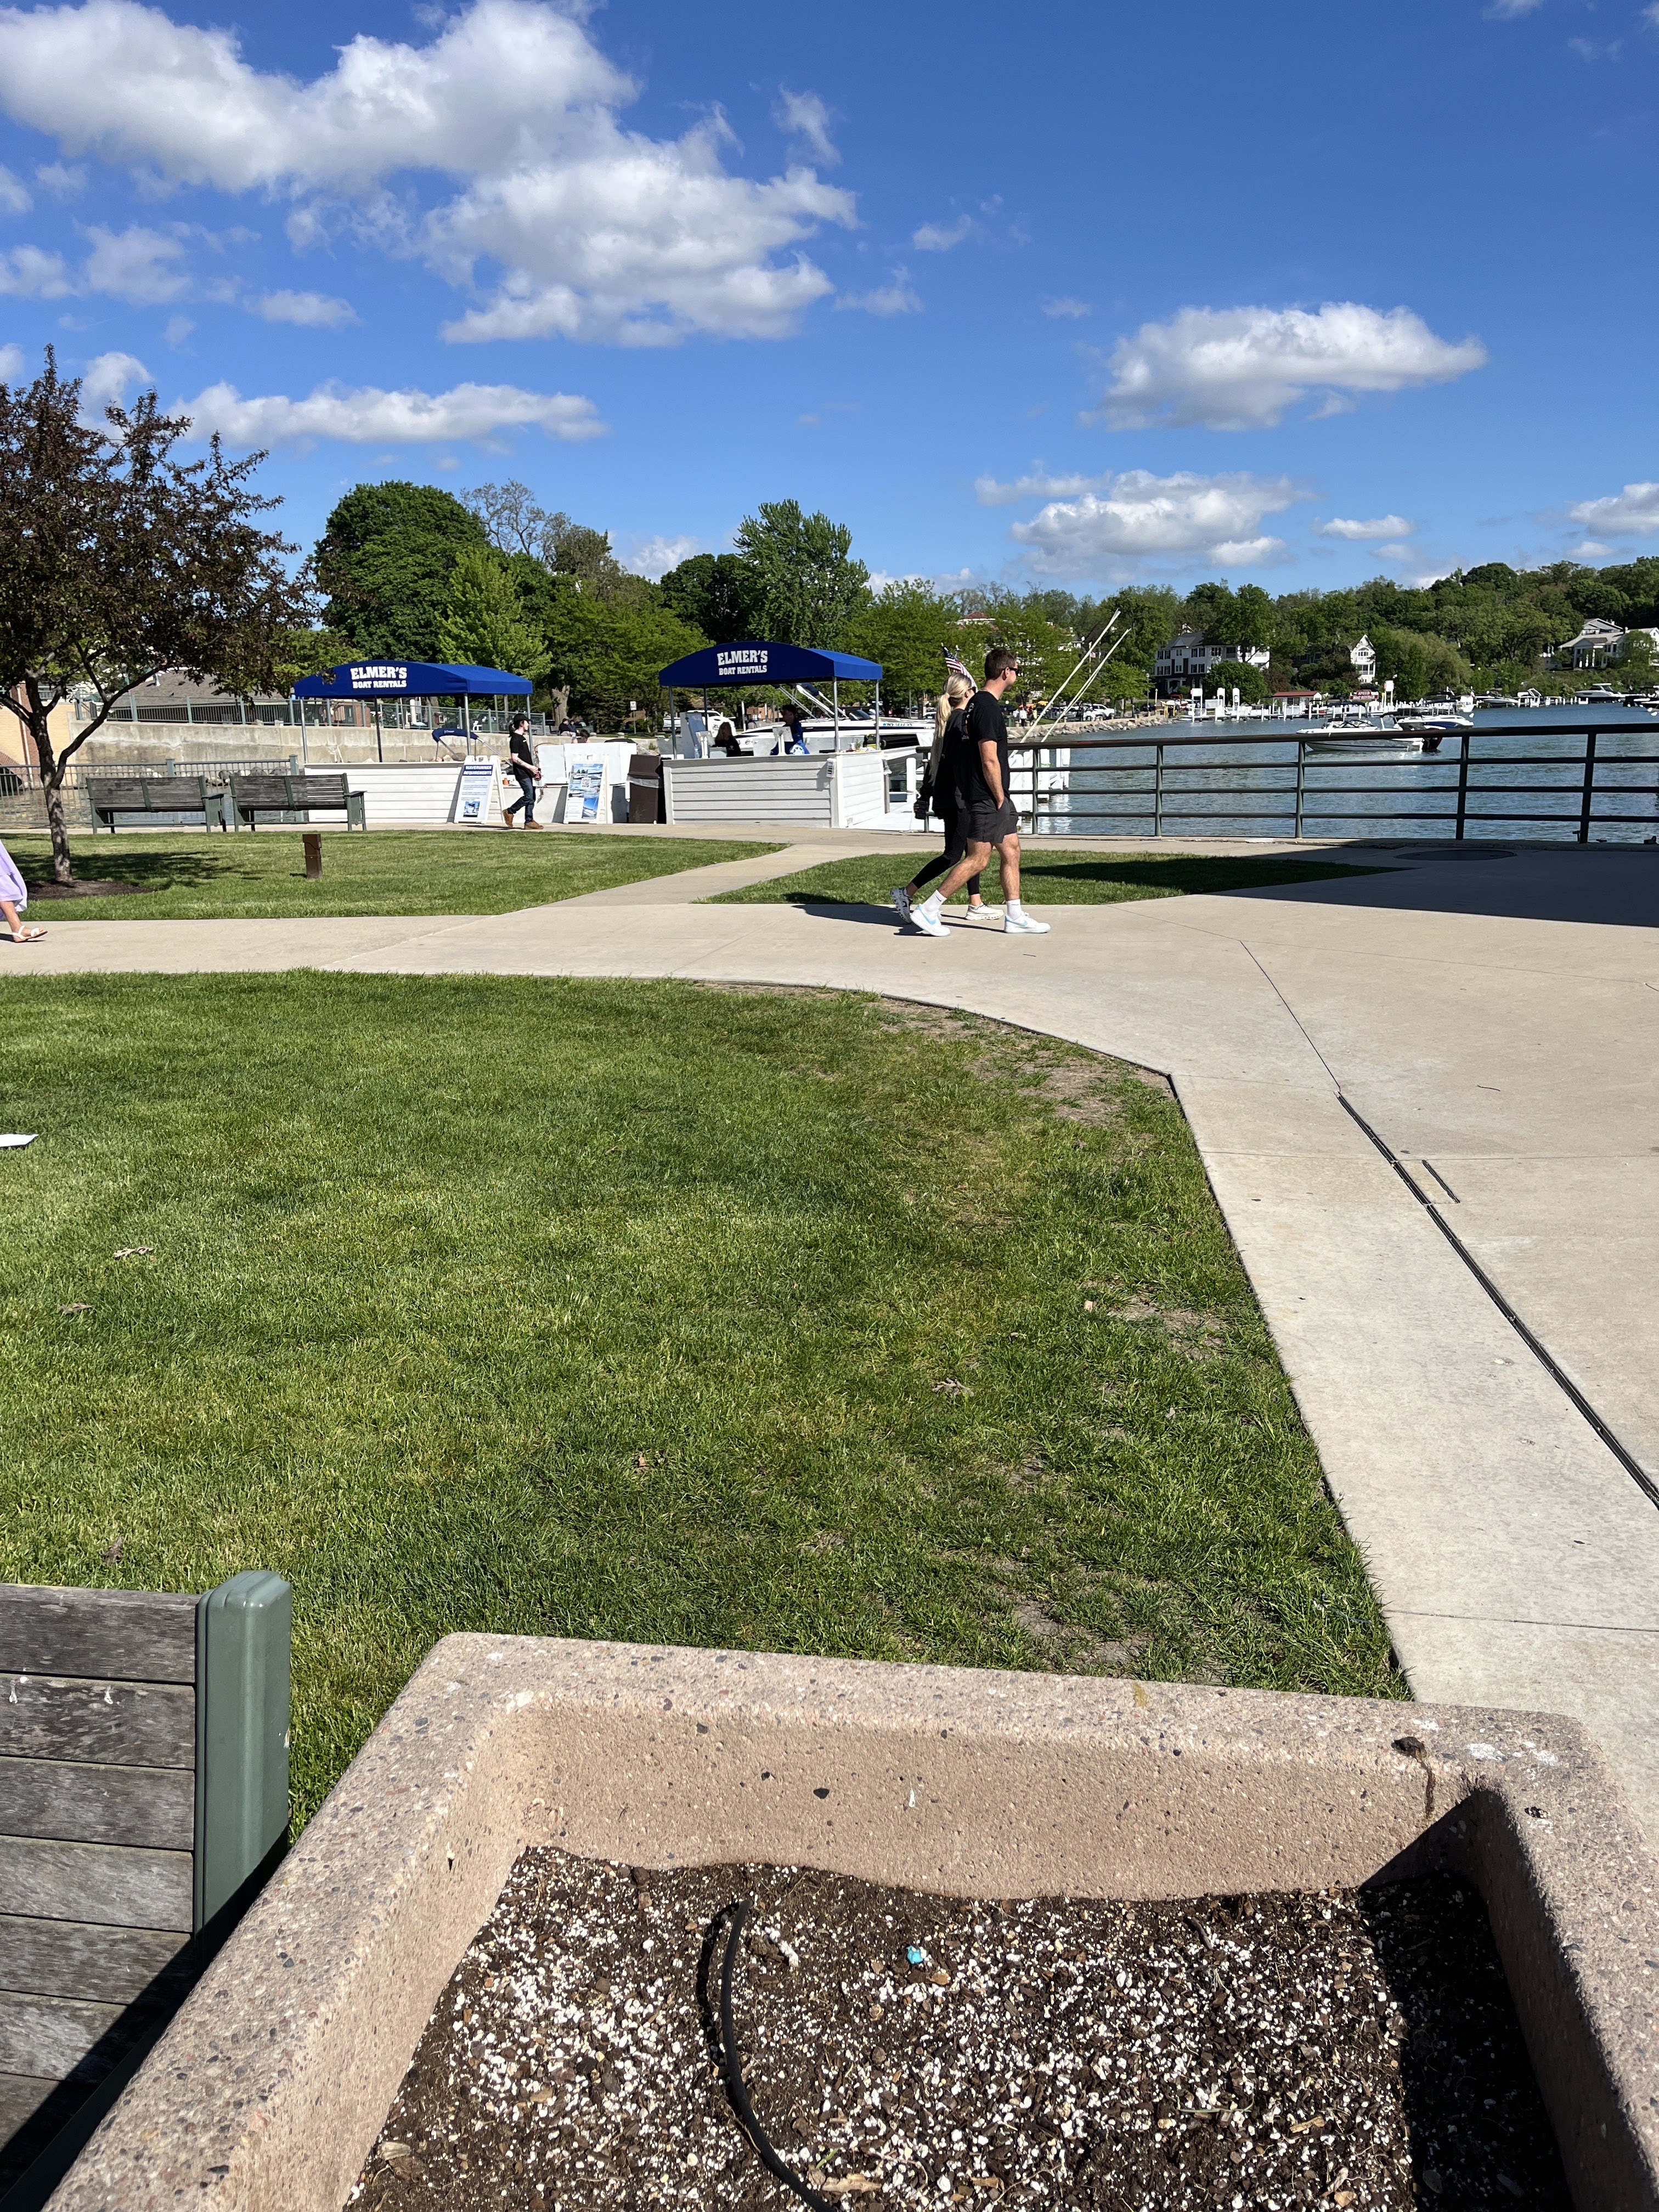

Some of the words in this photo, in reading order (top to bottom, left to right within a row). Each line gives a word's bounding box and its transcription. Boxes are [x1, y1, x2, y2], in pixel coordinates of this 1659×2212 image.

[717, 650, 768, 665] ELMER'S
[350, 666, 407, 680] ELMER'S
[719, 667, 736, 675] BOAT
[737, 665, 768, 675] RENTALS
[373, 680, 407, 689] RENTALS
